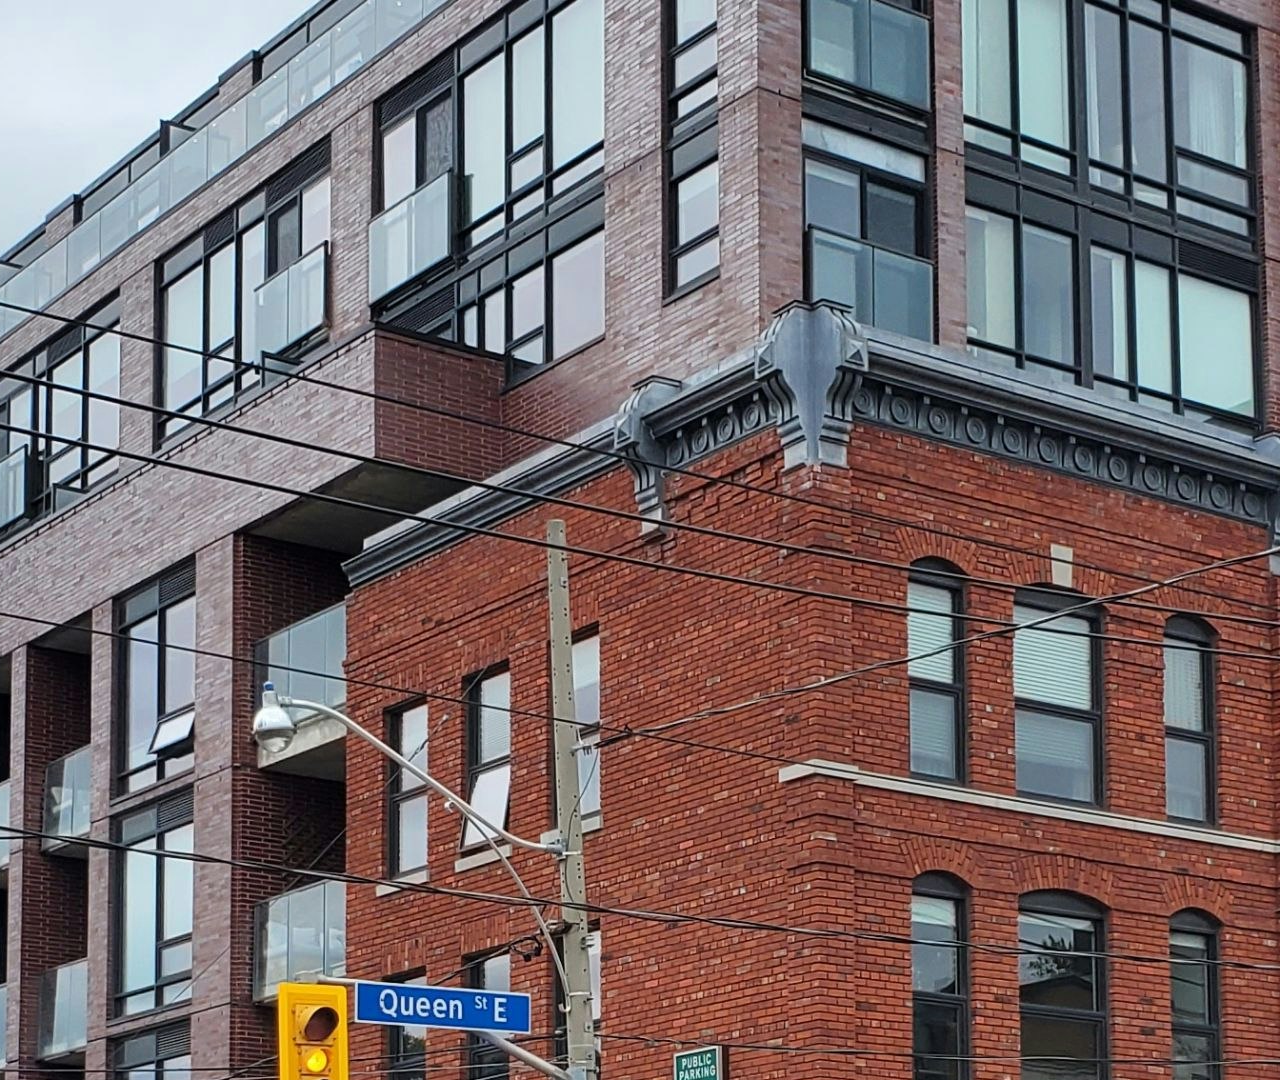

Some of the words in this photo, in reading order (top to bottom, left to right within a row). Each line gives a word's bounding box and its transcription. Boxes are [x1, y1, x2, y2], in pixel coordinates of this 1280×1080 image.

[379, 989, 463, 1020] Queen
[474, 995, 488, 1010] St
[494, 997, 507, 1022] E
[682, 1053, 712, 1070] PUBLIC
